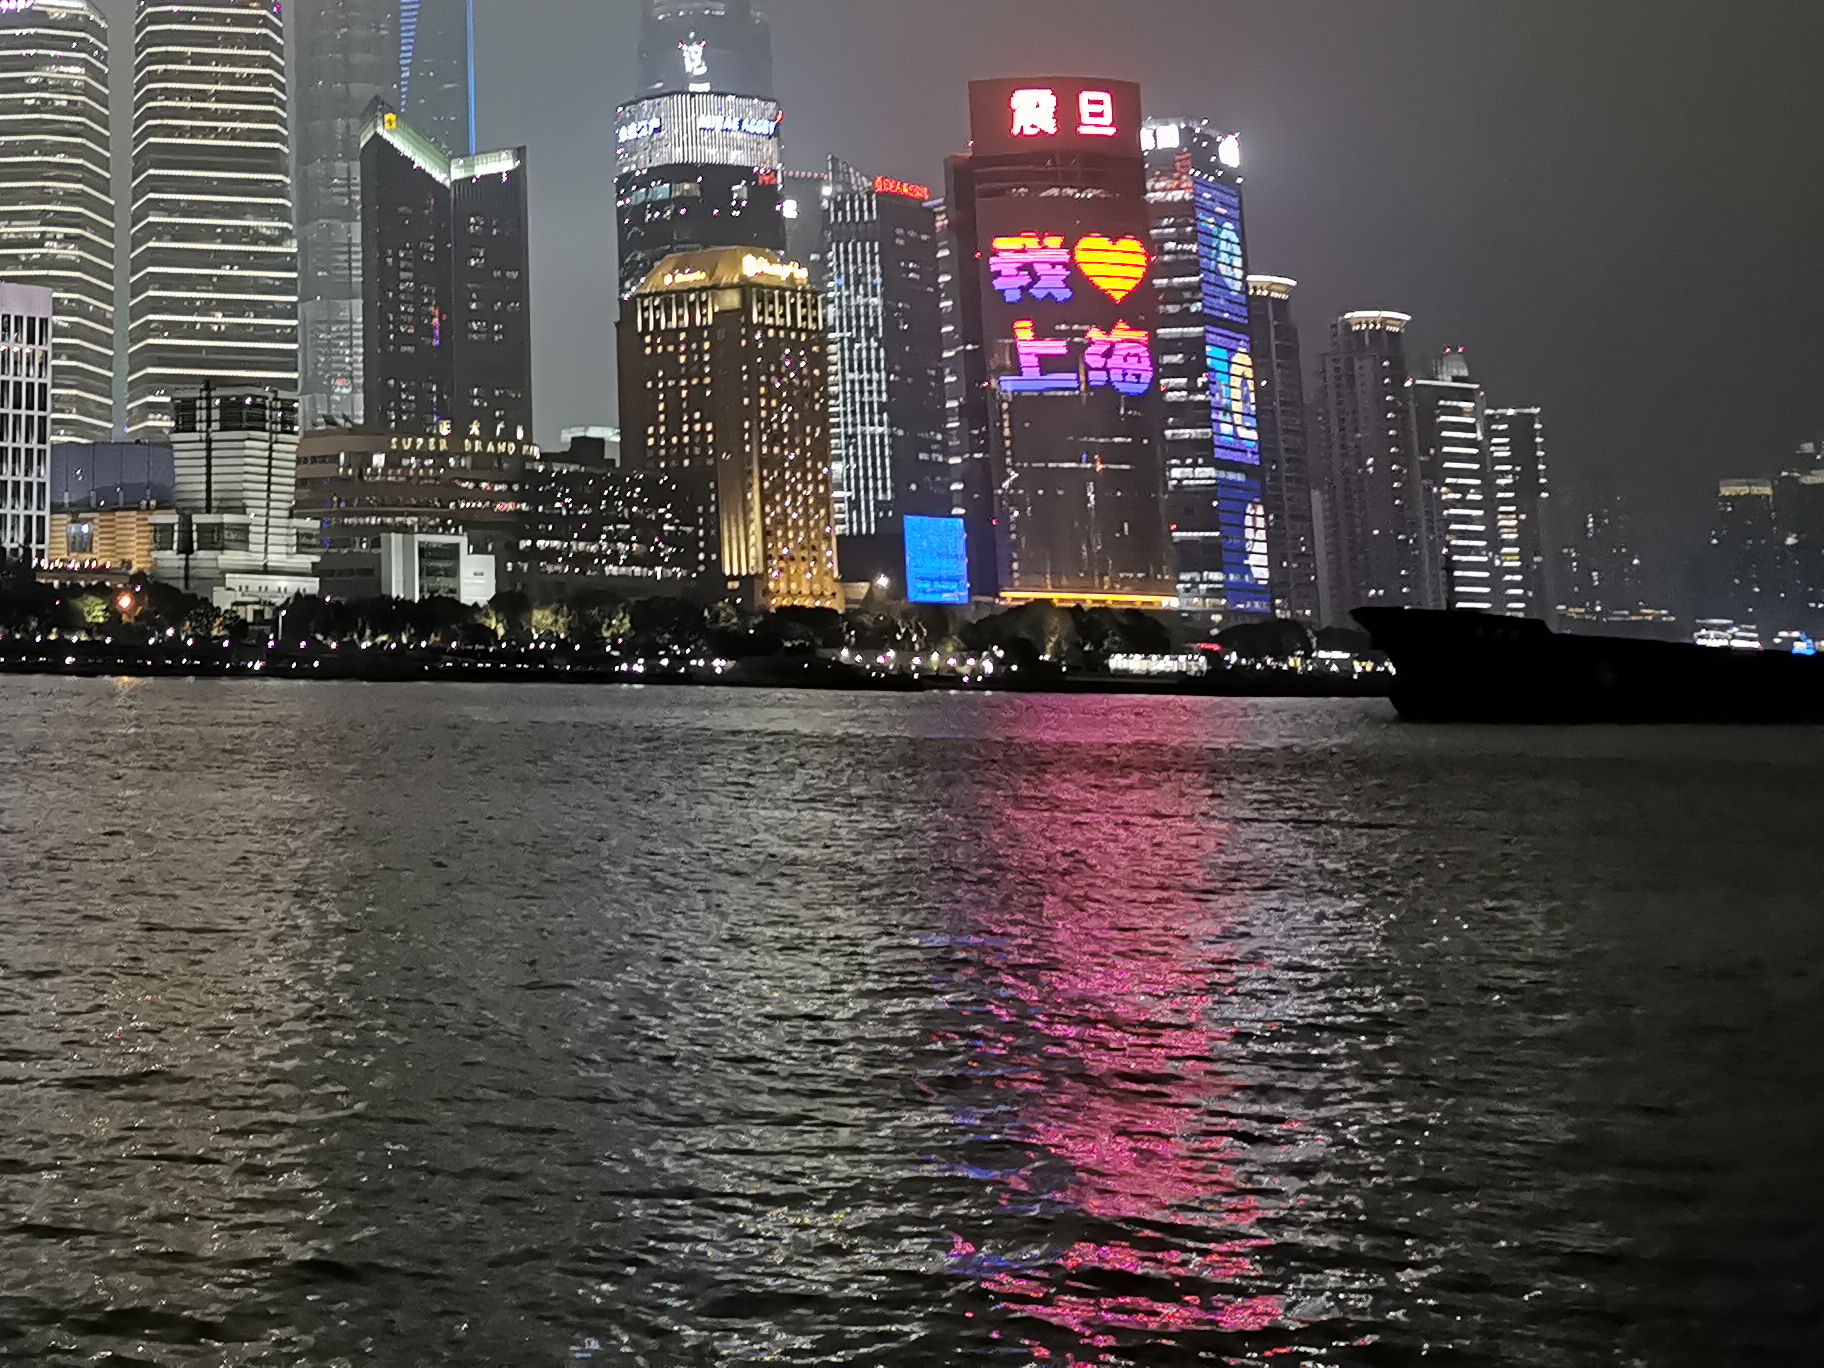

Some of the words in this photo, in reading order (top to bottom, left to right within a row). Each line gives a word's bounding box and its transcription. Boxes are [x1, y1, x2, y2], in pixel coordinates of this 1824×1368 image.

[989, 231, 1074, 304] 我
[999, 318, 1155, 397] 上海
[390, 437, 449, 452] SUPER
[463, 438, 517, 456] BRAND
